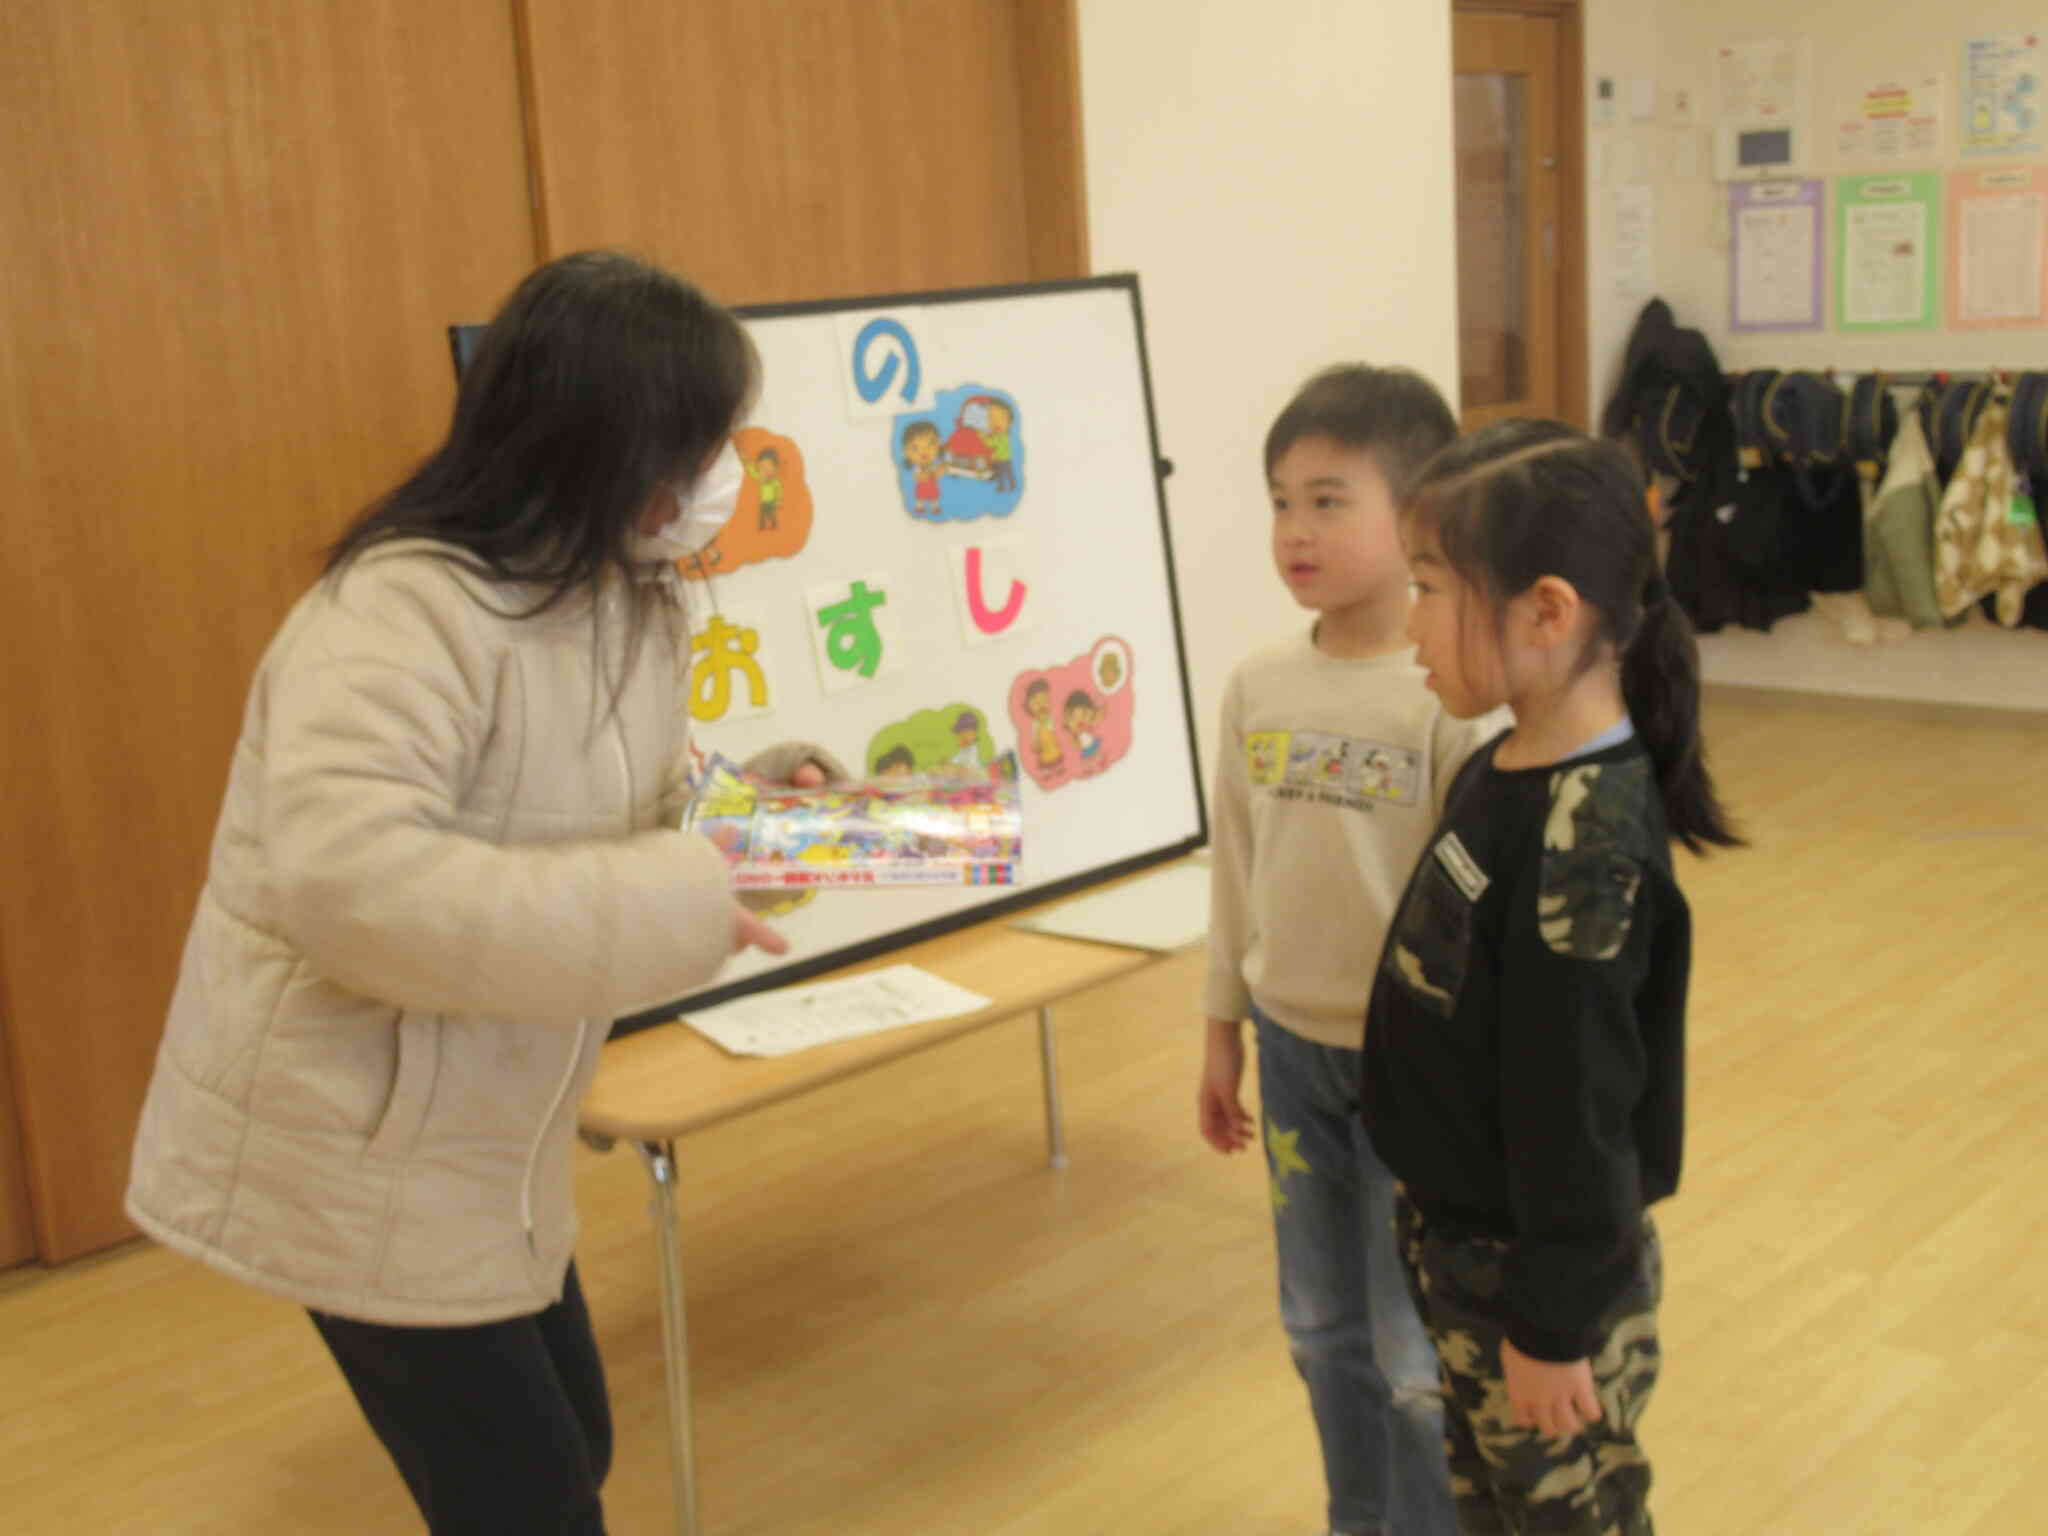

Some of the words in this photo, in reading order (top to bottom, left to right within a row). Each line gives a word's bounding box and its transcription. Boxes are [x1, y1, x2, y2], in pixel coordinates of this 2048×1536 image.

[853, 318, 922, 404] の
[816, 581, 887, 677] す
[966, 547, 1027, 635] し
[688, 615, 768, 722] お
